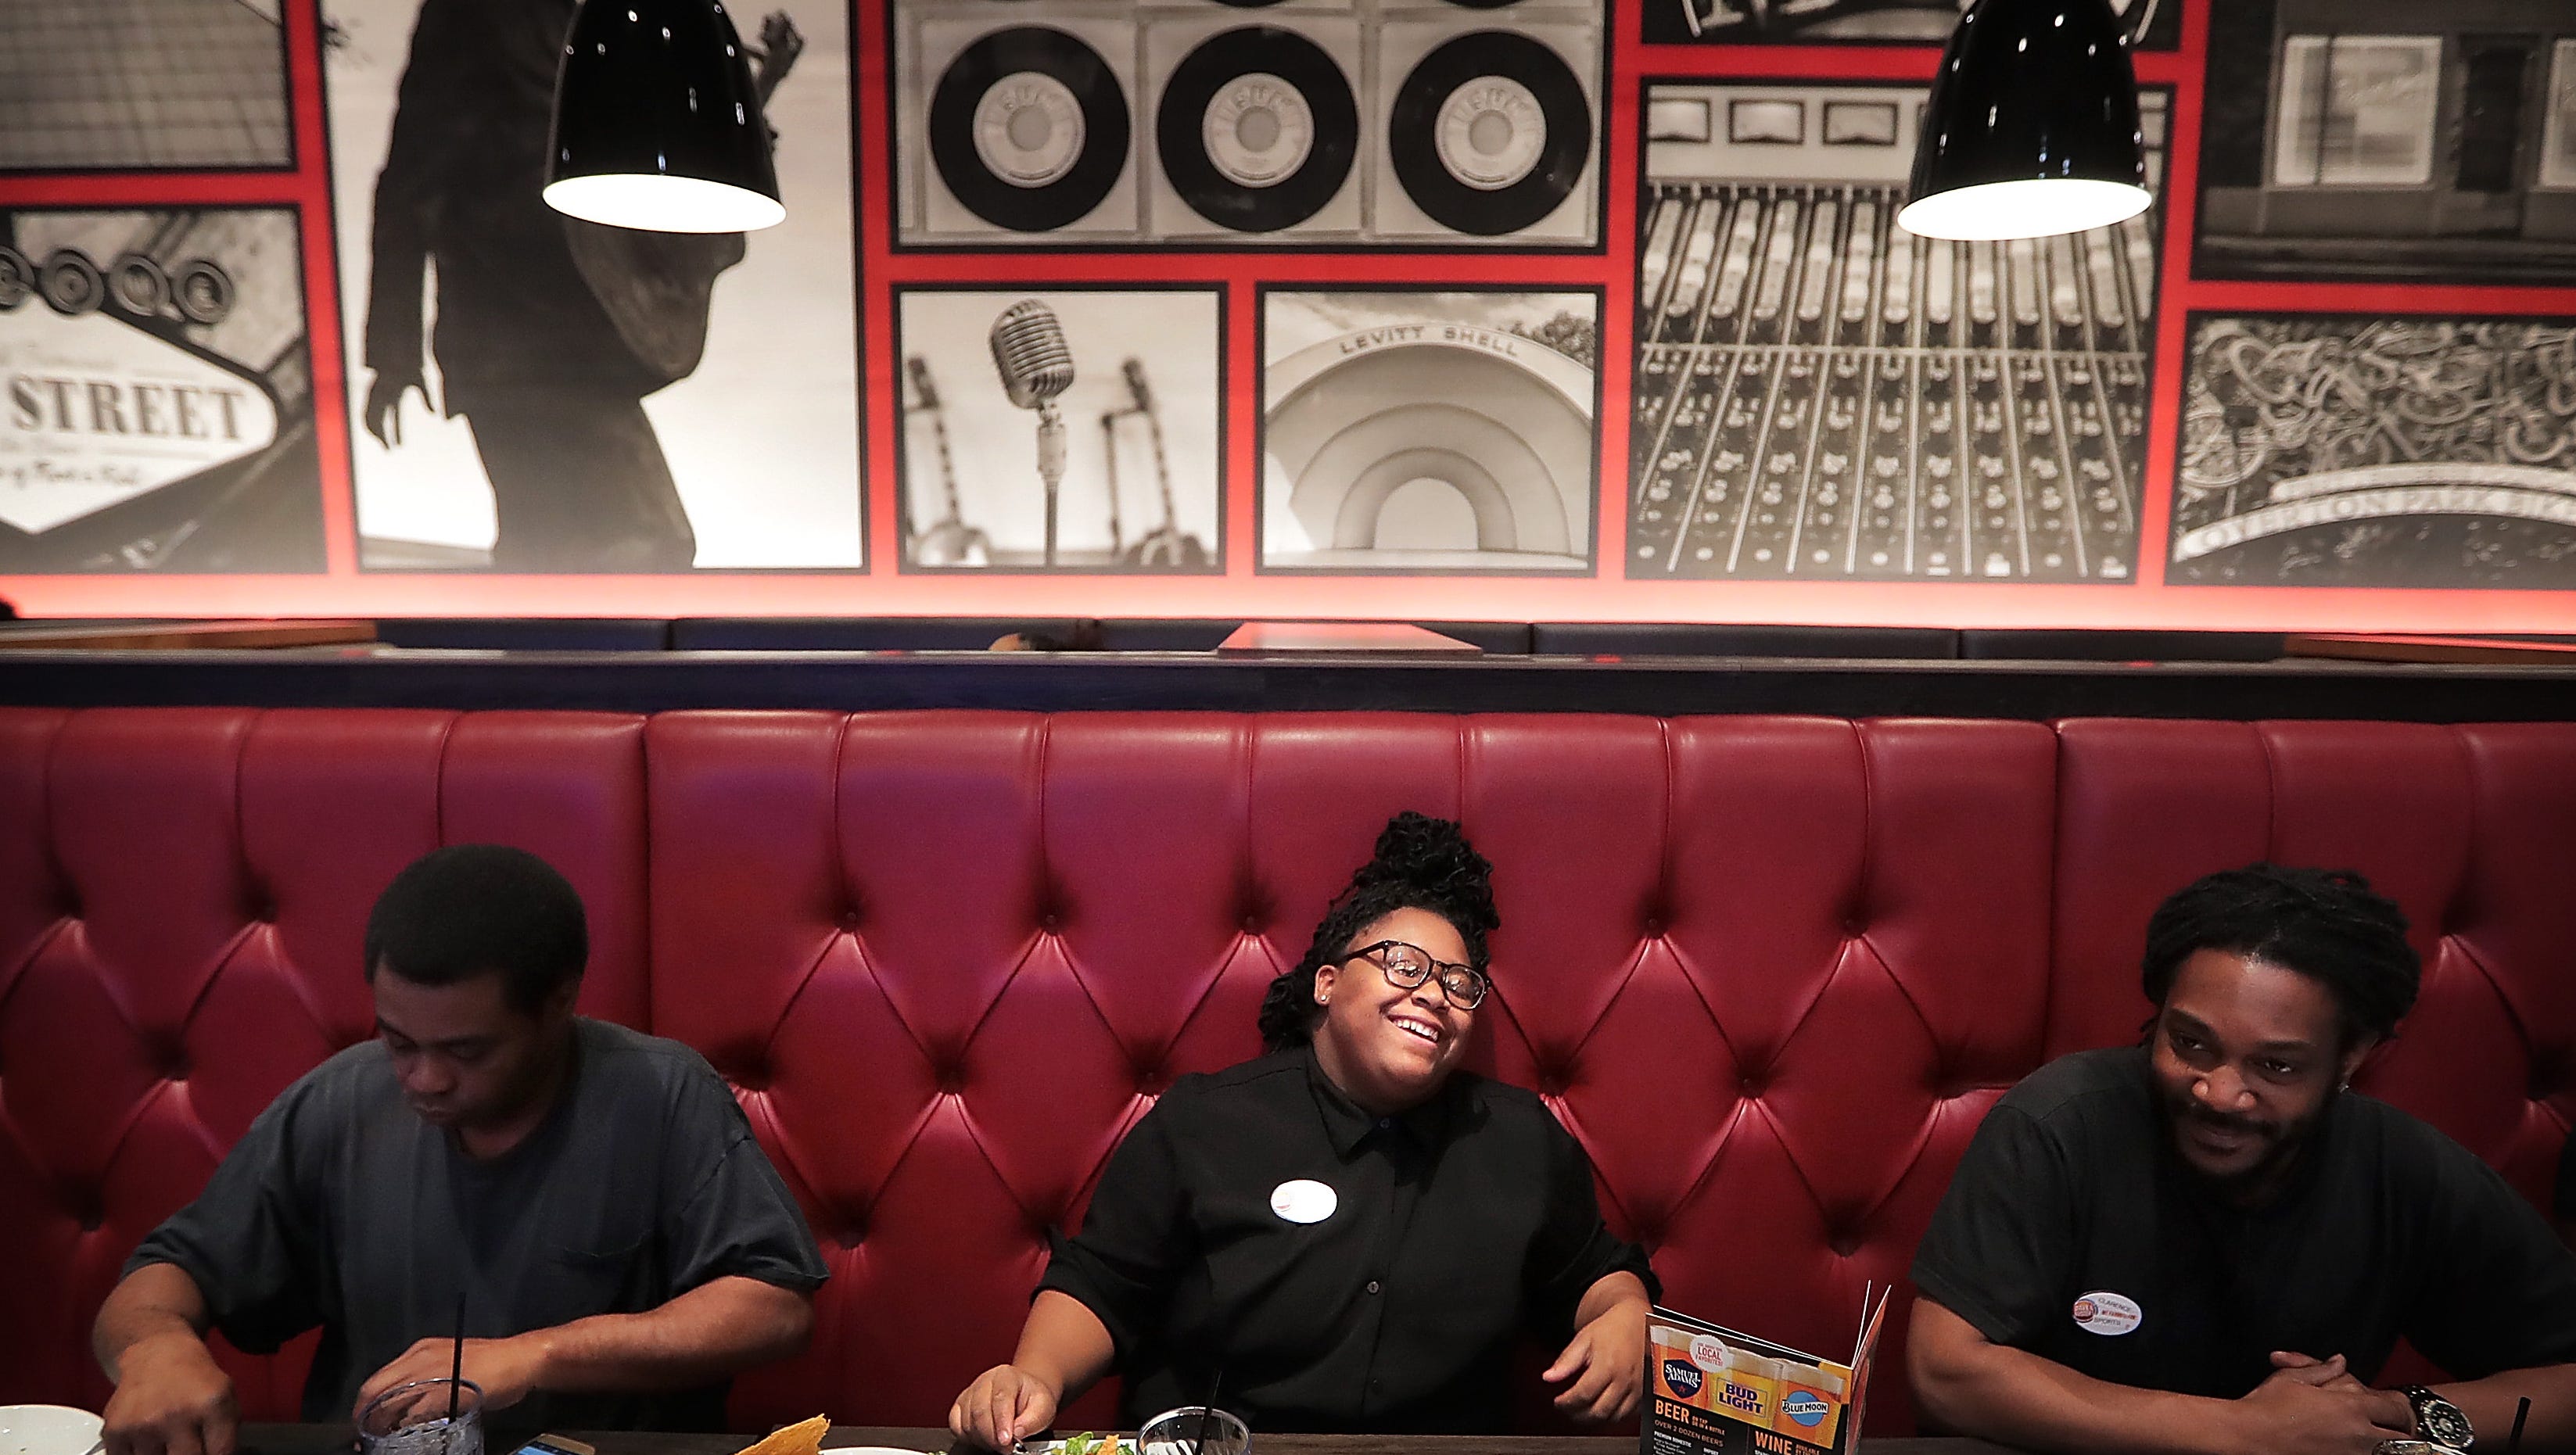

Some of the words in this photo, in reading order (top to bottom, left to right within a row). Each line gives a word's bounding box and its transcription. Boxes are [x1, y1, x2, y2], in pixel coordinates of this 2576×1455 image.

[1340, 326, 1425, 353] LEVITT
[1444, 327, 1518, 357] SHELL
[9, 374, 244, 441] STREET
[1698, 1346, 1722, 1360] LOCAL
[1665, 1364, 1701, 1382] SAMUEL
[1667, 1372, 1698, 1388] ADAMS
[1719, 1392, 1763, 1414] LIGHT
[1725, 1383, 1758, 1401] BUD
[1656, 1399, 1689, 1424] BEER
[1781, 1399, 1803, 1413] BLUE
[1804, 1403, 1828, 1412] MOON
[1654, 1419, 1672, 1430] OVER
[1678, 1427, 1700, 1439] DOZEN
[1702, 1435, 1724, 1447] BEERS
[1755, 1430, 1792, 1455] WINE
